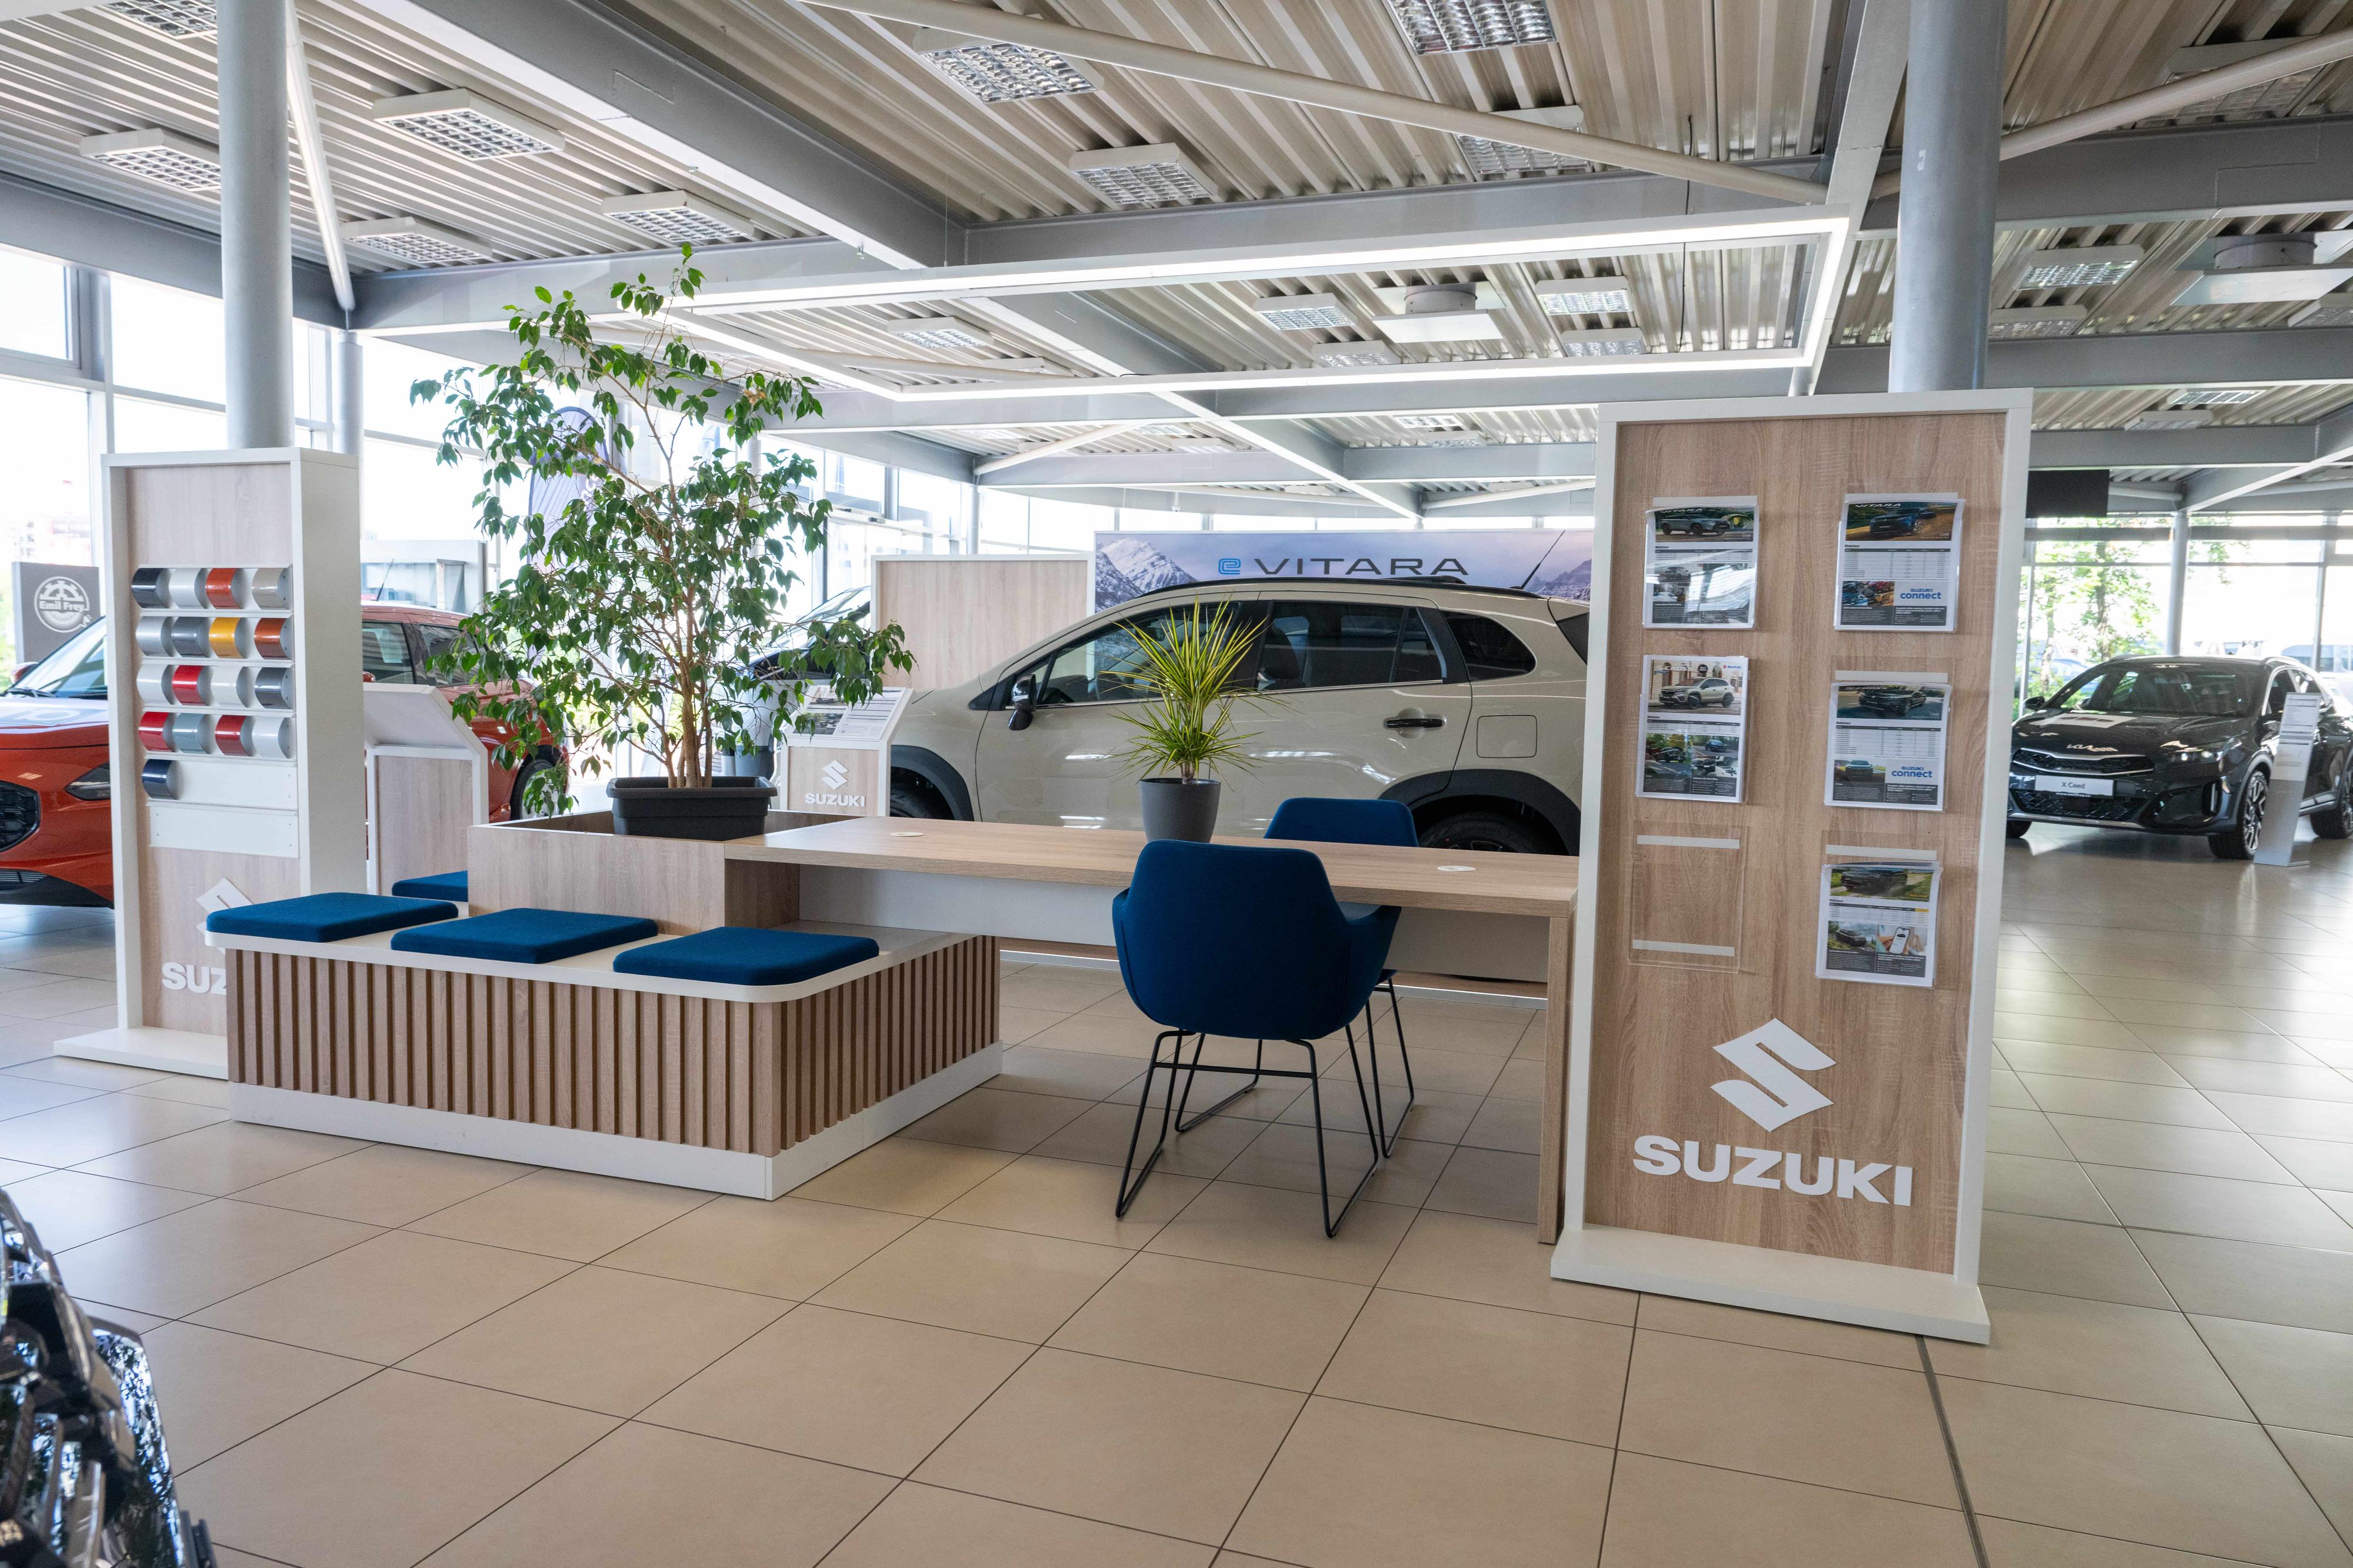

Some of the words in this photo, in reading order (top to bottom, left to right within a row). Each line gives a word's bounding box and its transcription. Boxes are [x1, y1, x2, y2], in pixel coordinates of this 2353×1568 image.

[1254, 558, 1469, 575] VITARA
[39, 600, 62, 610] Emil
[63, 602, 85, 612] Frey
[804, 793, 866, 806] SUZUKI
[162, 962, 226, 995] SUZ
[1632, 1135, 1913, 1207] SUZUKI
